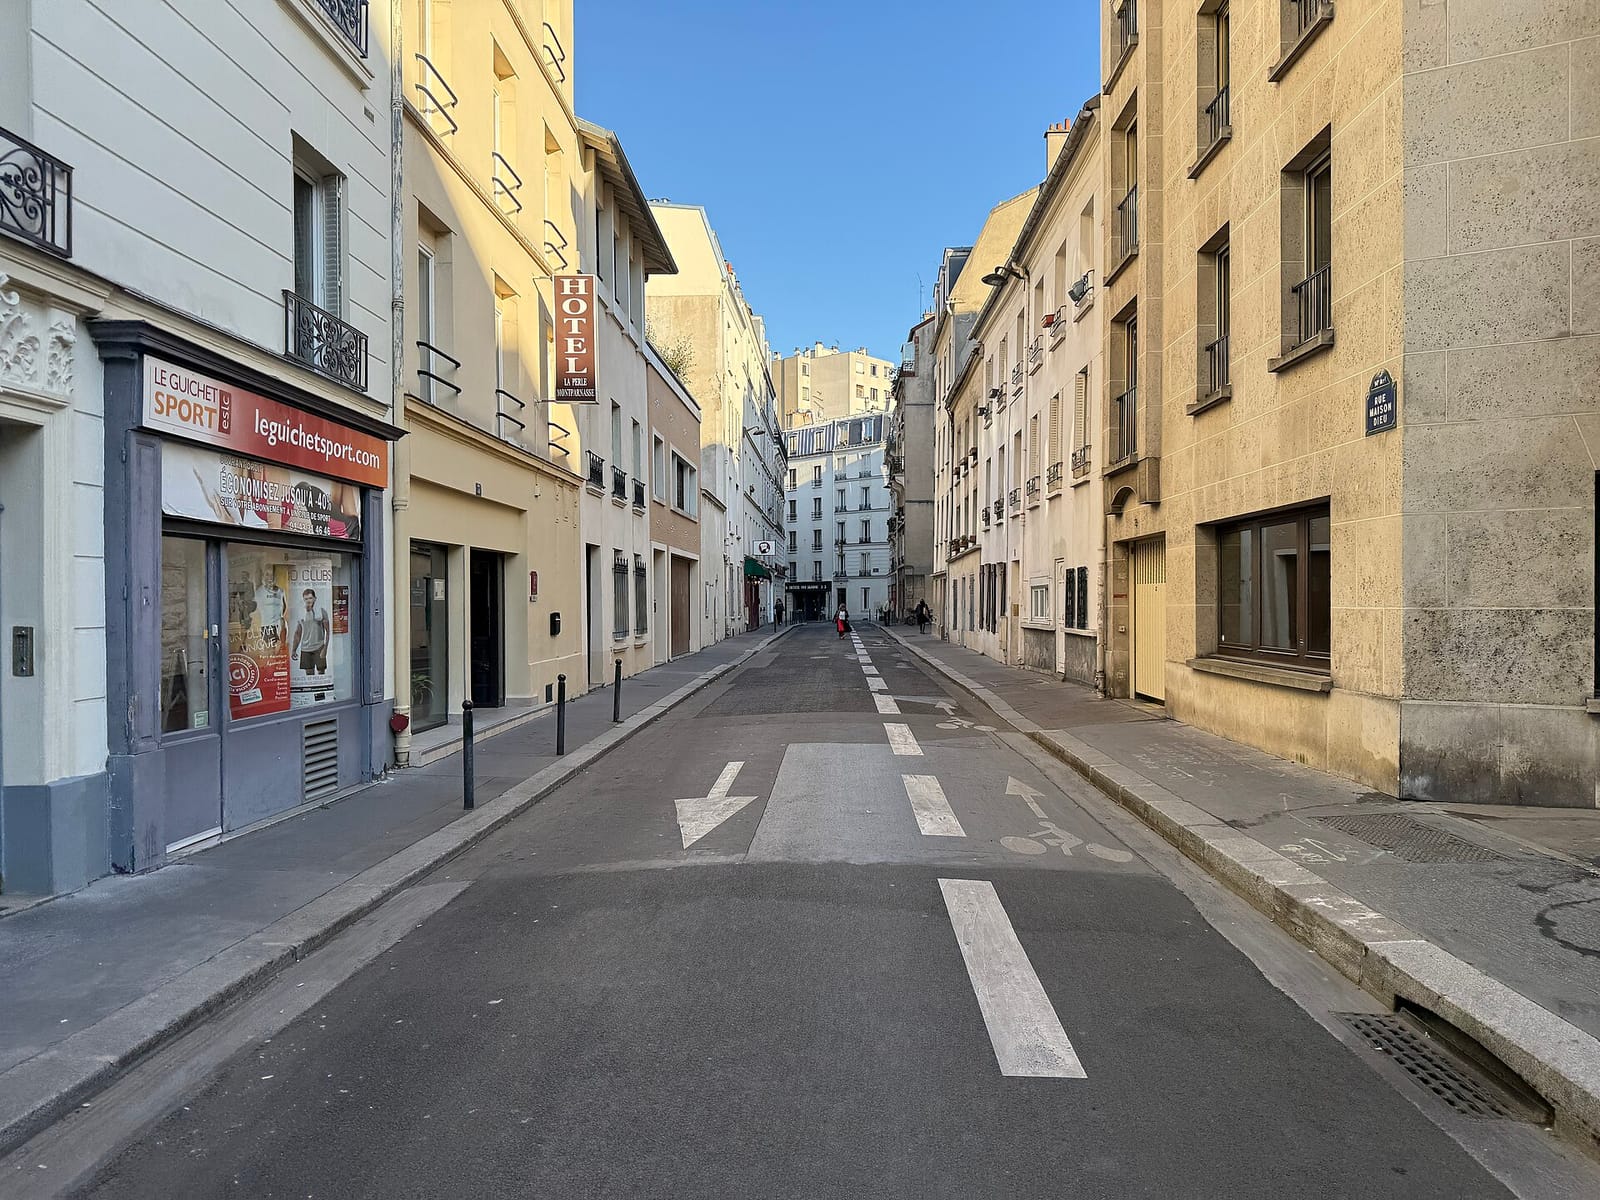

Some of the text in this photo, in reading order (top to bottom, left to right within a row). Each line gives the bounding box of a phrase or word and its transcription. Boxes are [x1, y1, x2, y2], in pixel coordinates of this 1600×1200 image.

[560, 278, 588, 374] HOTEL
[154, 366, 218, 403] LE GUICHET
[563, 377, 588, 387] LA PERLE
[556, 388, 595, 397] MONTPARNASSE
[154, 390, 217, 429] SPORT
[1369, 402, 1392, 418] MAISON
[1373, 414, 1388, 427] DIEU
[254, 408, 380, 469] leguichetsport.com
[219, 465, 280, 501] ÉCONOMISEZ
[281, 483, 314, 508] JUSQU'À
[317, 513, 331, 523] SPORT
[301, 569, 332, 582] CLUBS
